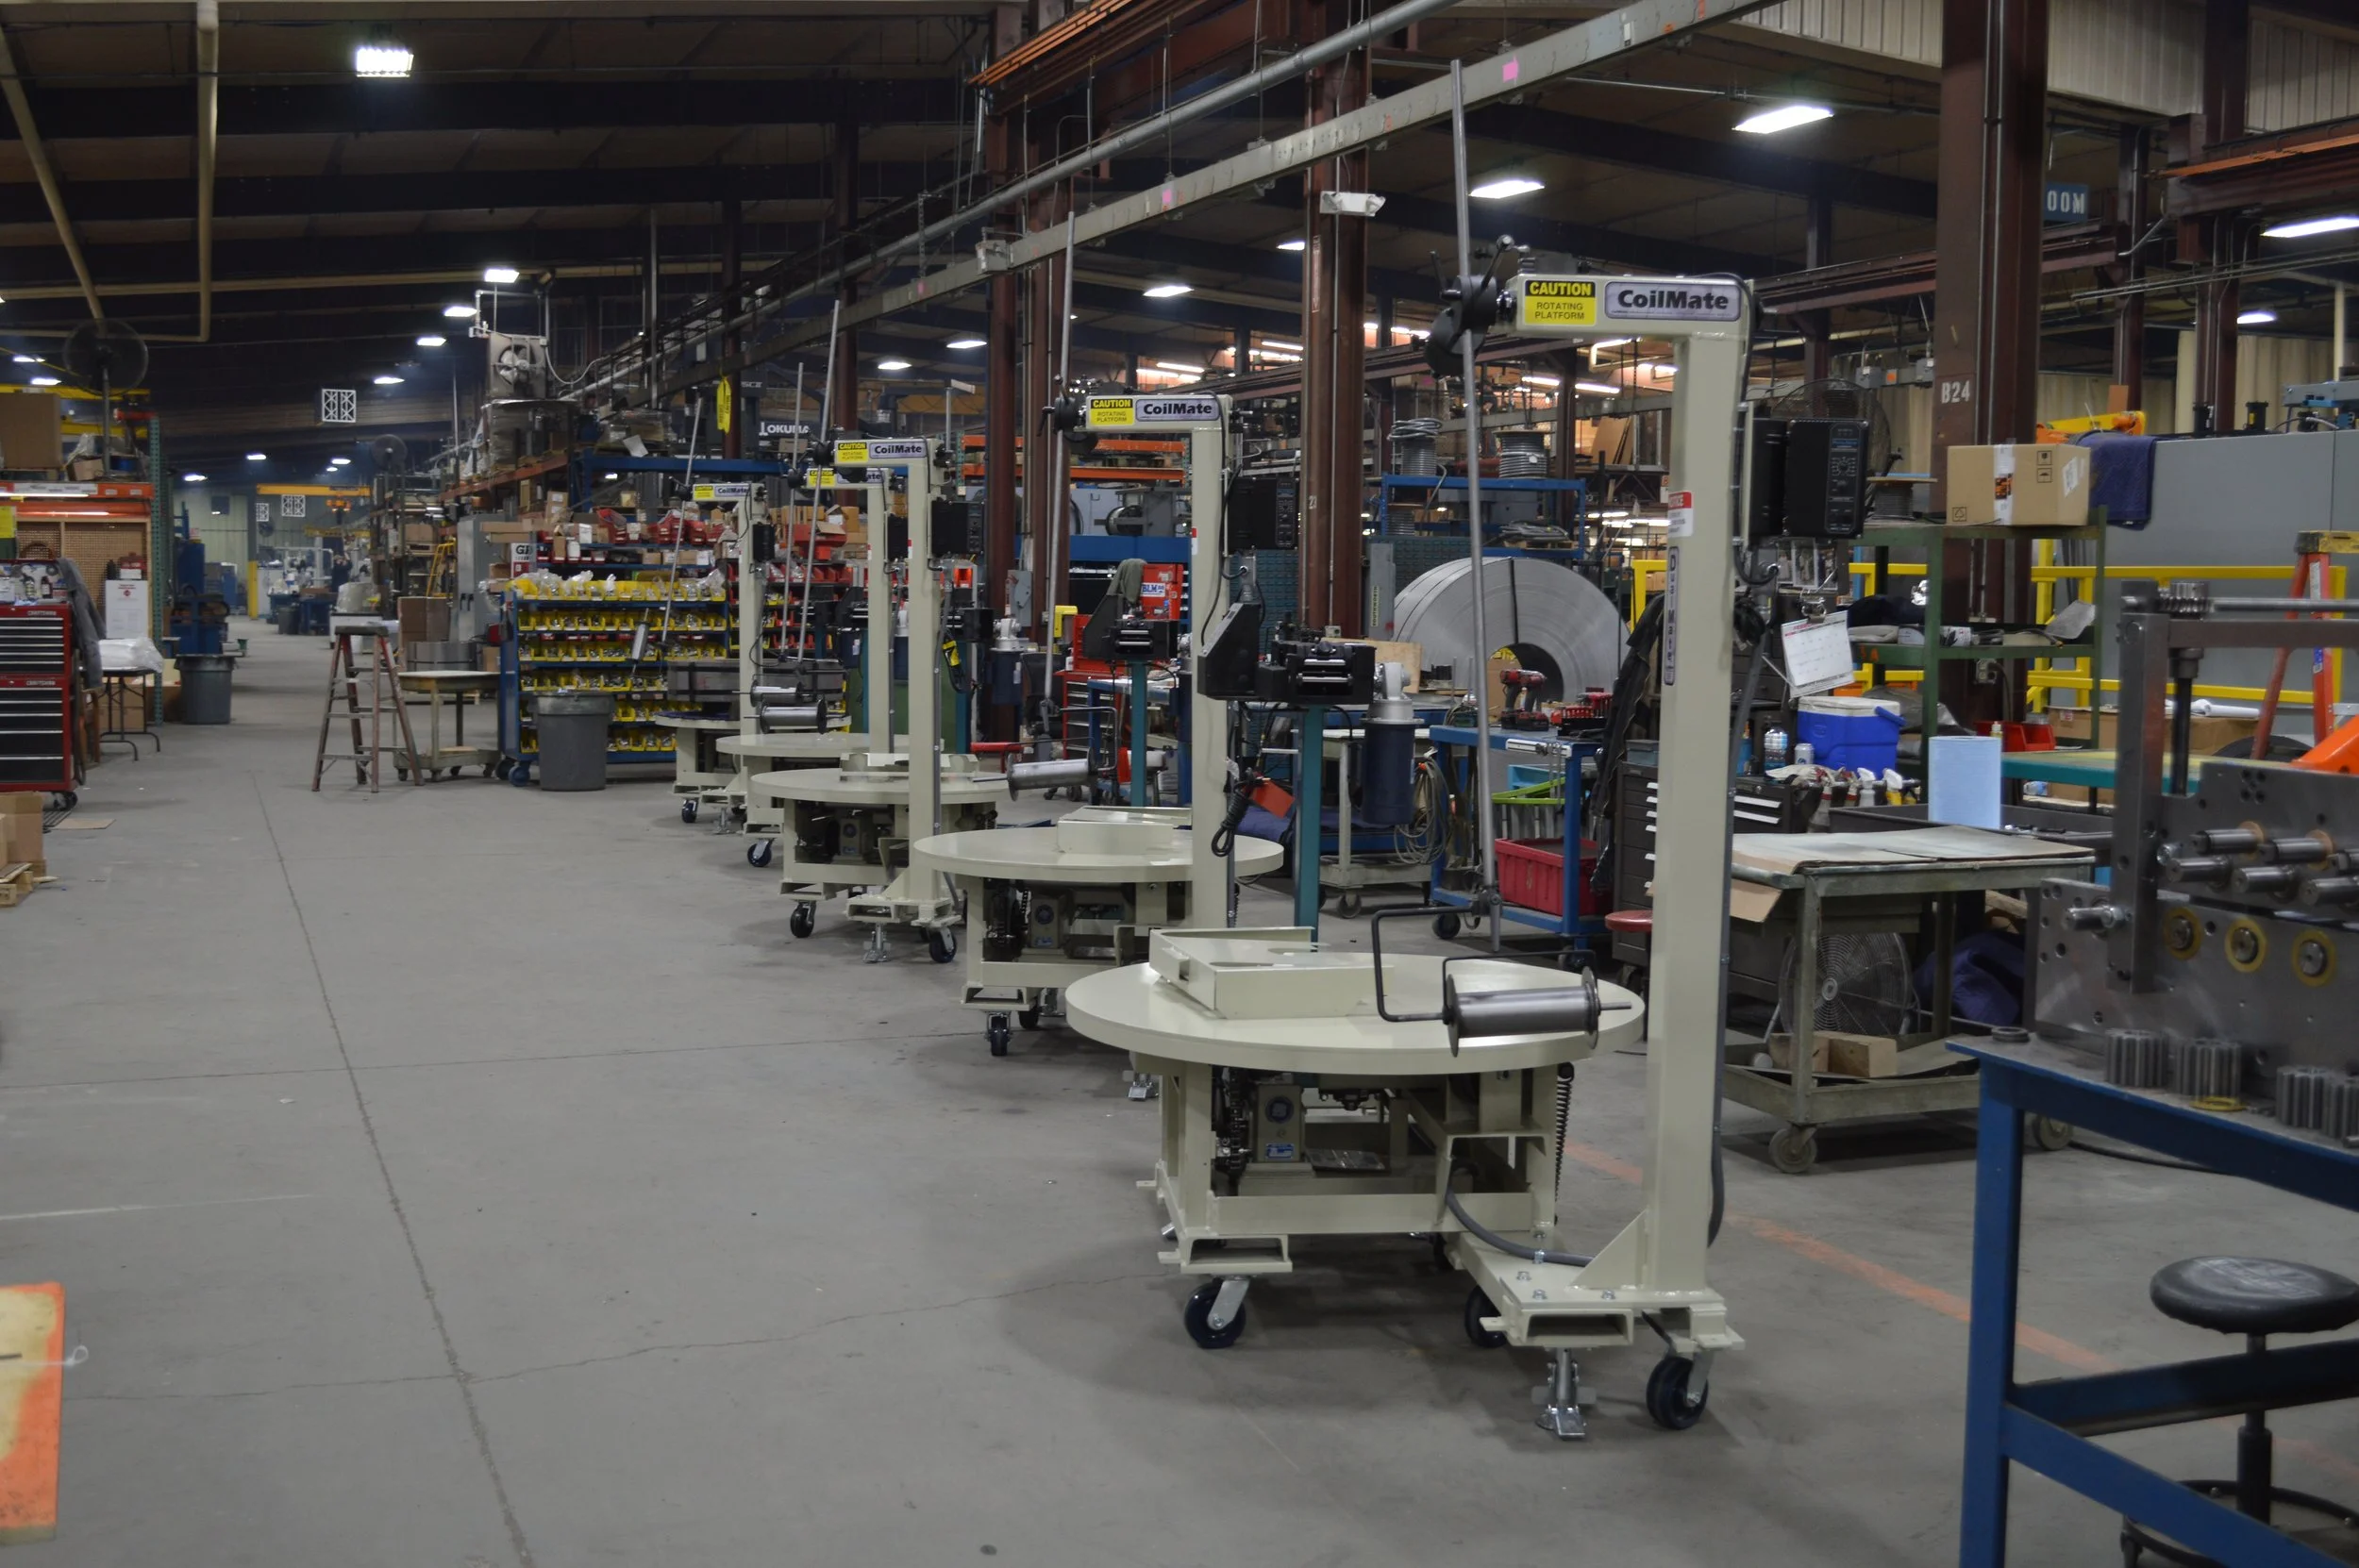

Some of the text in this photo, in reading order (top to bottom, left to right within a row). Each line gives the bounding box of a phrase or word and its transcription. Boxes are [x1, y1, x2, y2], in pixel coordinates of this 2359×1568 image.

[2047, 191, 2085, 214] OOM
[1529, 281, 1592, 295] CAUTION
[1617, 290, 1729, 310] CoilMate
[1536, 302, 1583, 310] ROTATING
[1534, 311, 1585, 320] PLATFORM
[1941, 380, 1970, 404] B24
[1093, 399, 1131, 408] CAUTION
[1143, 404, 1213, 415] CoilMate
[874, 445, 922, 454] CoilMate
